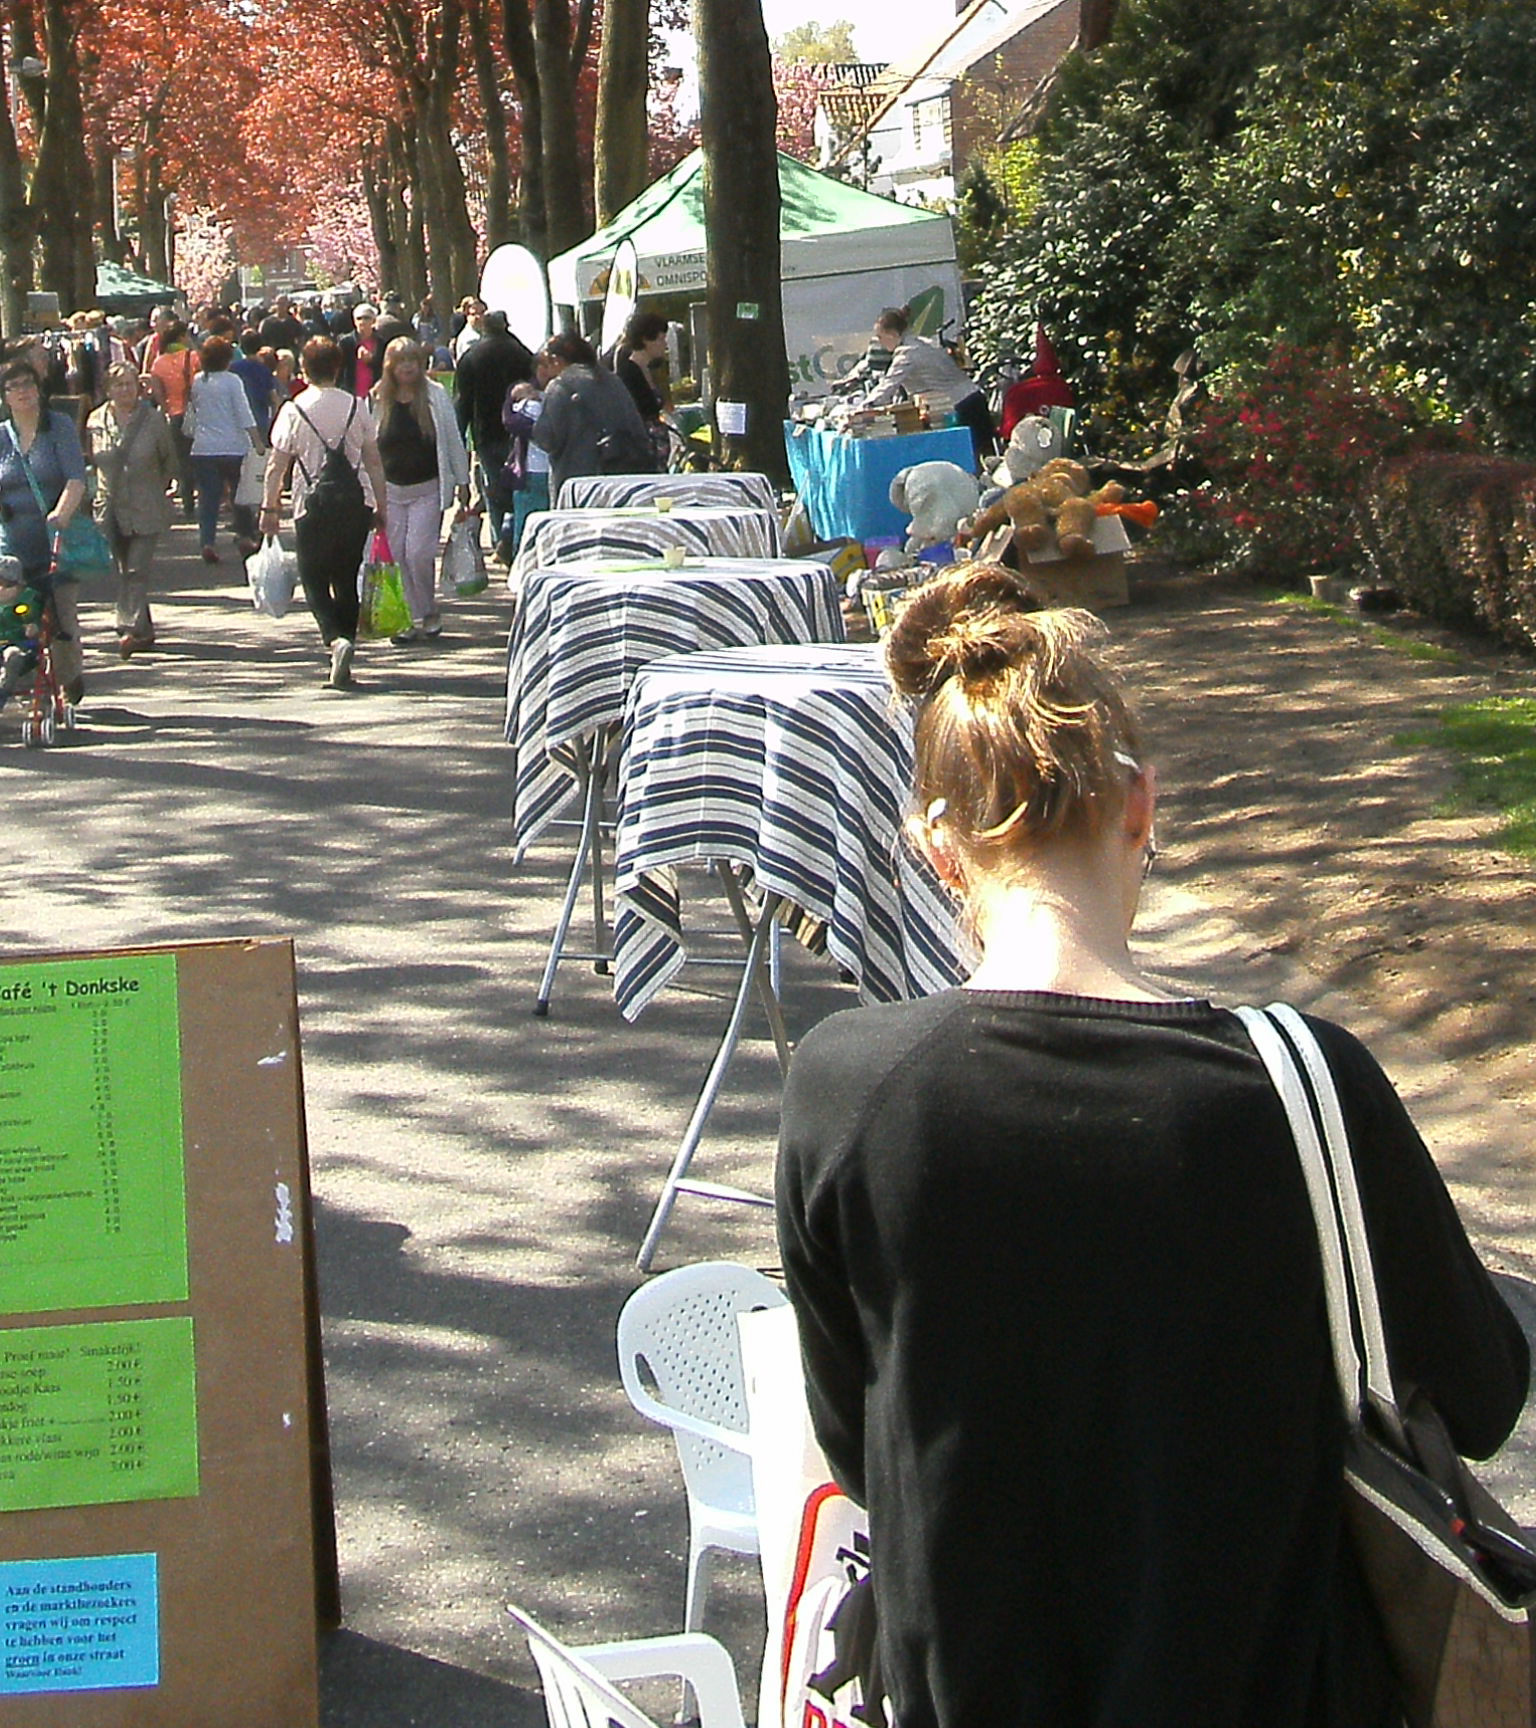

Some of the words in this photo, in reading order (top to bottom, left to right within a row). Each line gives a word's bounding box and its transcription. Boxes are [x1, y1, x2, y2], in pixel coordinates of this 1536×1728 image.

[655, 253, 705, 269] VLAAMSE
[656, 270, 706, 286] OMNISPO
[42, 981, 58, 997] 't
[66, 976, 140, 996] Donkske
[4, 1350, 34, 1363] Proef
[6, 1585, 30, 1596] Aan
[33, 1583, 47, 1594] de
[50, 1580, 131, 1594] standhouders
[5, 1604, 19, 1614] en
[22, 1601, 37, 1612] de
[40, 1597, 136, 1611] marktbezoekers
[5, 1619, 46, 1631] vragen
[50, 1616, 69, 1629] wij
[71, 1617, 90, 1626] om
[95, 1614, 137, 1627] respect
[5, 1638, 17, 1648] te
[19, 1635, 63, 1647] hebben
[67, 1635, 94, 1644] voor
[97, 1631, 116, 1642] het
[5, 1654, 39, 1668] groen
[42, 1652, 55, 1662] in
[58, 1651, 84, 1661] onze
[90, 1649, 125, 1660] straat
